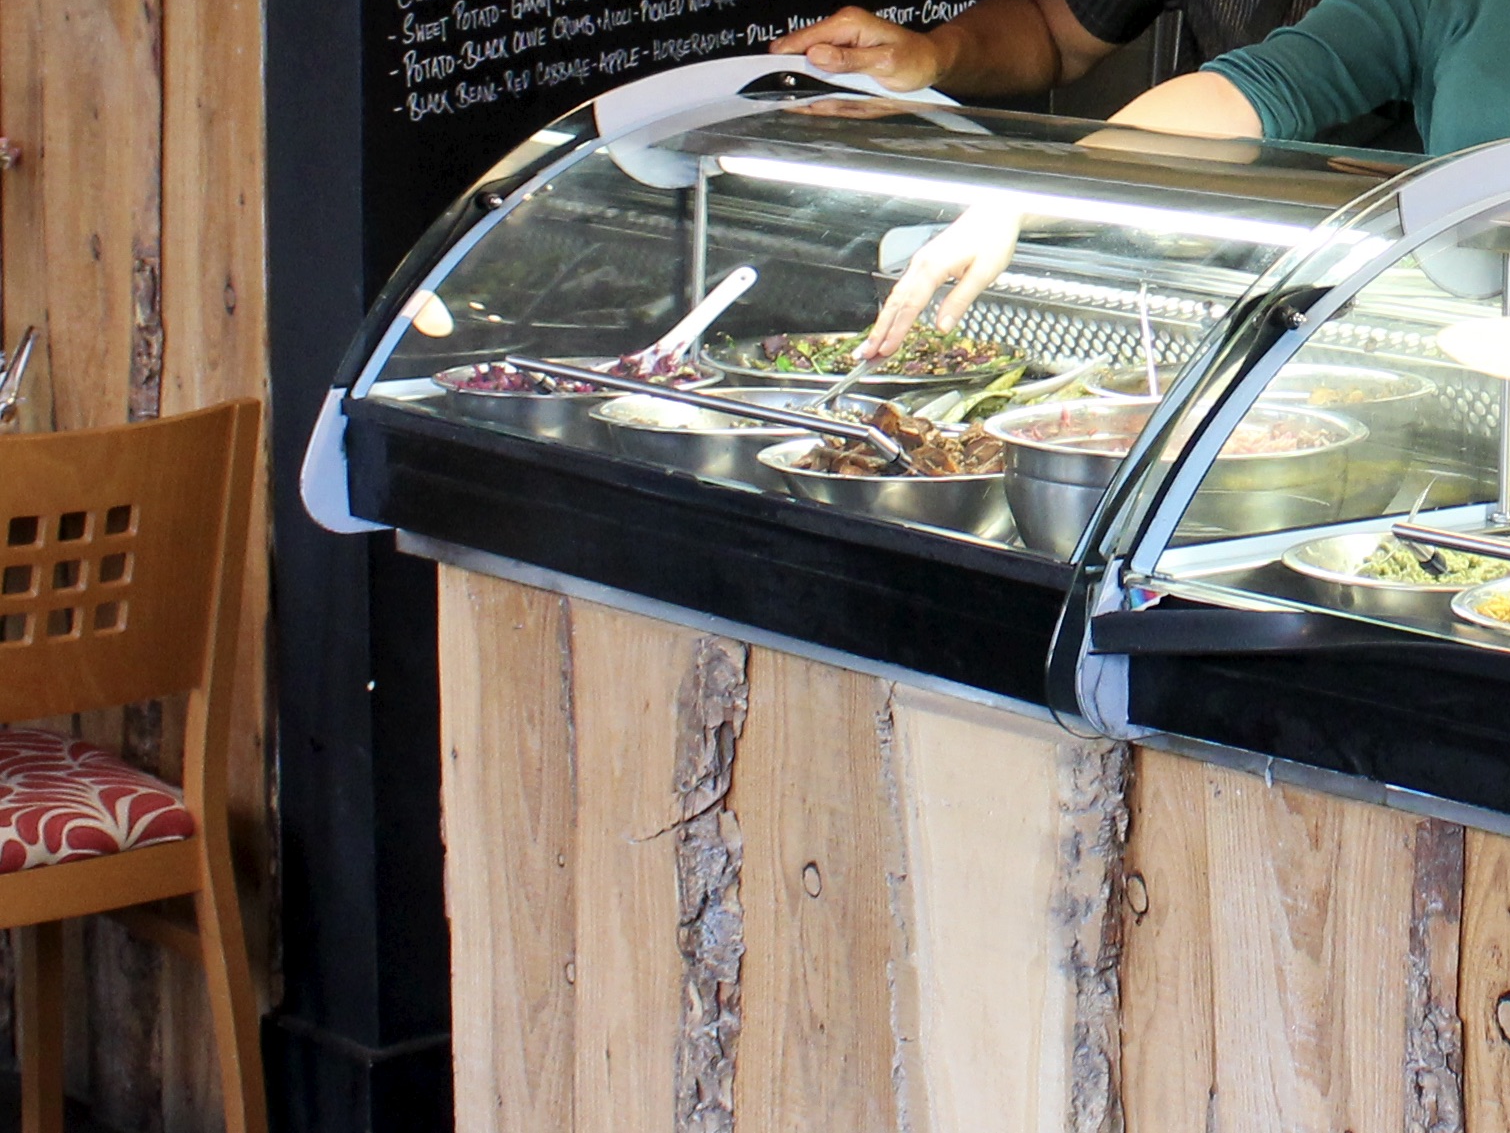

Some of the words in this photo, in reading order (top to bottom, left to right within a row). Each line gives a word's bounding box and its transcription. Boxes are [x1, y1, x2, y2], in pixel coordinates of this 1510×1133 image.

[402, 12, 449, 44] SWEET
[461, 41, 509, 69] BLACK
[406, 90, 454, 121] BLACK
